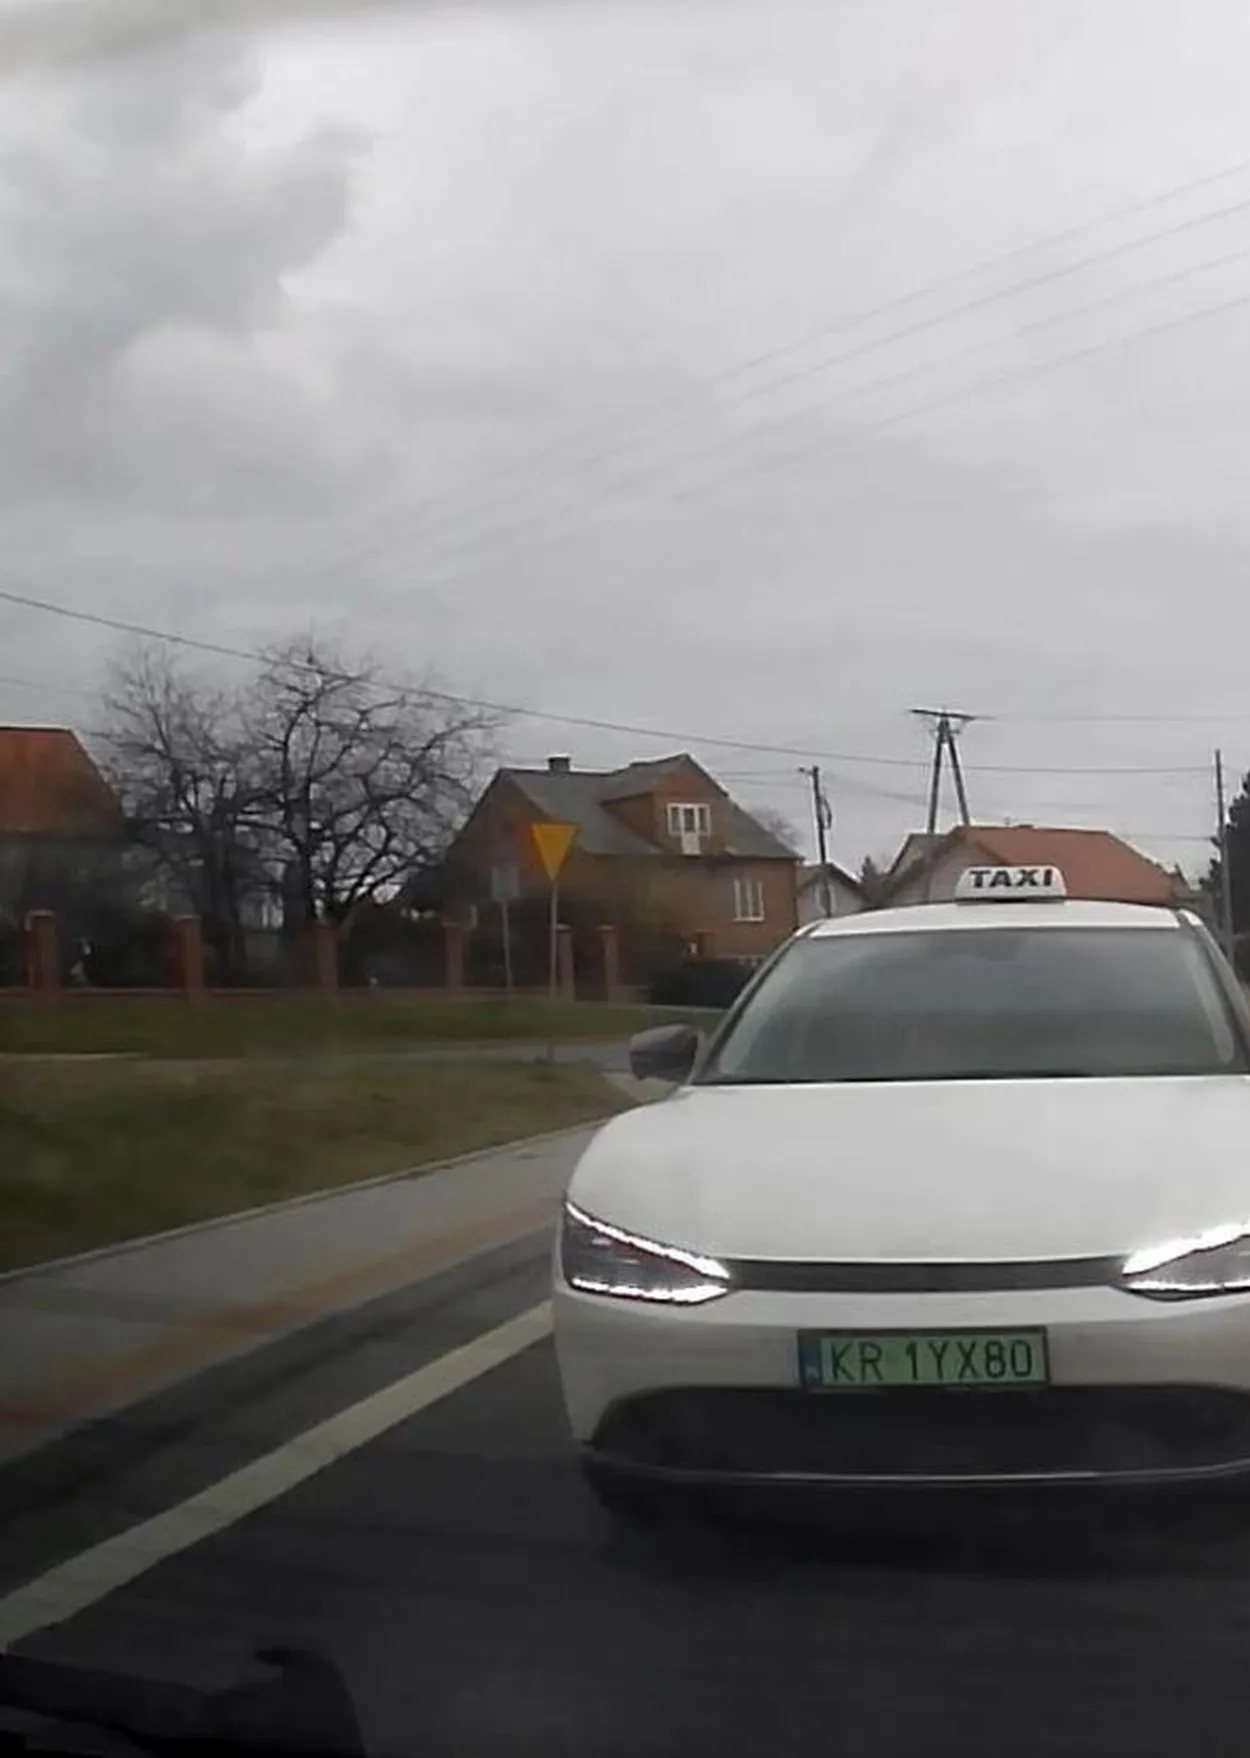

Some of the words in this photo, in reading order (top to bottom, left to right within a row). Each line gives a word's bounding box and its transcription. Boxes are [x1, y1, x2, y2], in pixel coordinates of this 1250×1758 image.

[969, 868, 1053, 888] TAXI
[830, 1341, 883, 1382] KR
[905, 1339, 1033, 1380] 1YX80
